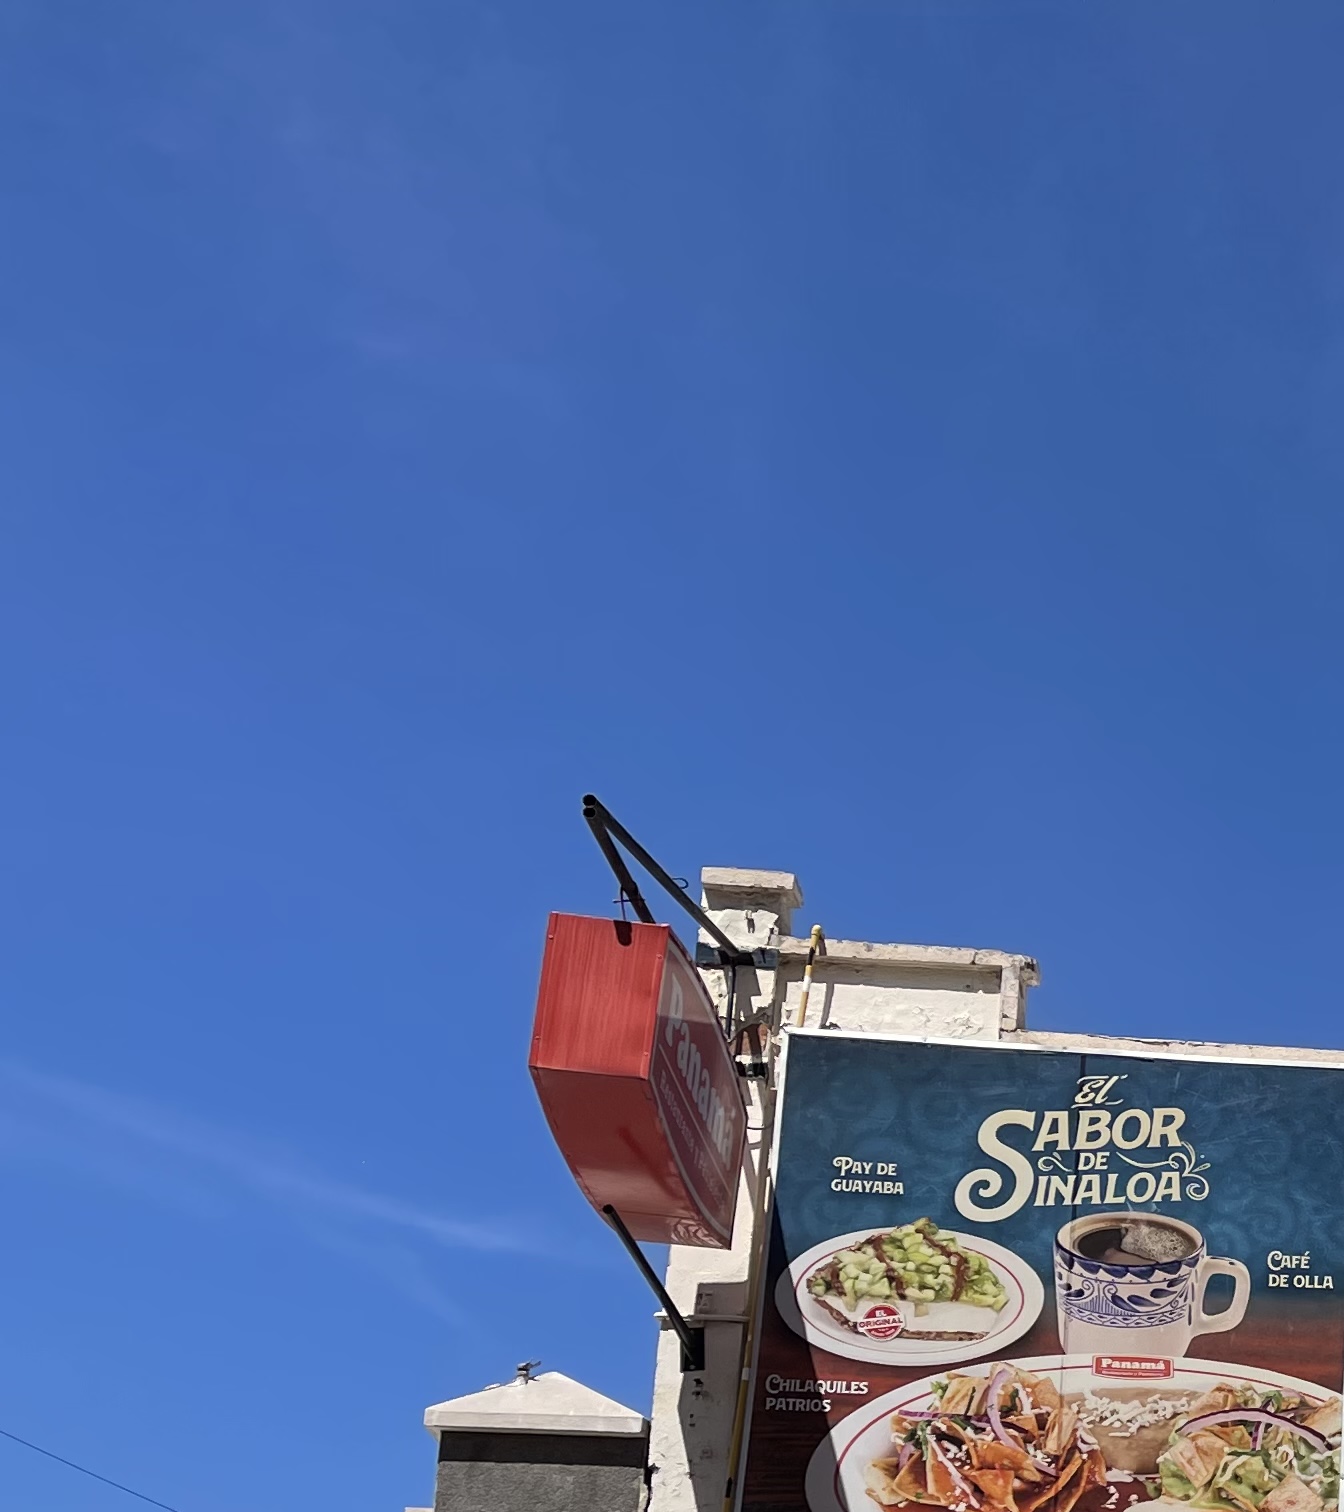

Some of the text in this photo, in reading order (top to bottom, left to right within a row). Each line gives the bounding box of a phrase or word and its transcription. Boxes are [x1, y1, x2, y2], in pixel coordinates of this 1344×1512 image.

[877, 1160, 897, 1176] DE
[1077, 1151, 1109, 1171] DE
[830, 1178, 904, 1196] GUAYABA
[1267, 1250, 1310, 1271] CAFÉ
[1268, 1272, 1333, 1289] DE OLLA
[859, 1317, 903, 1328] ORIGINAL
[1101, 1358, 1165, 1370] Panamá
[765, 1374, 868, 1394] CHILAQUILES
[765, 1397, 831, 1413] PATRIOS
